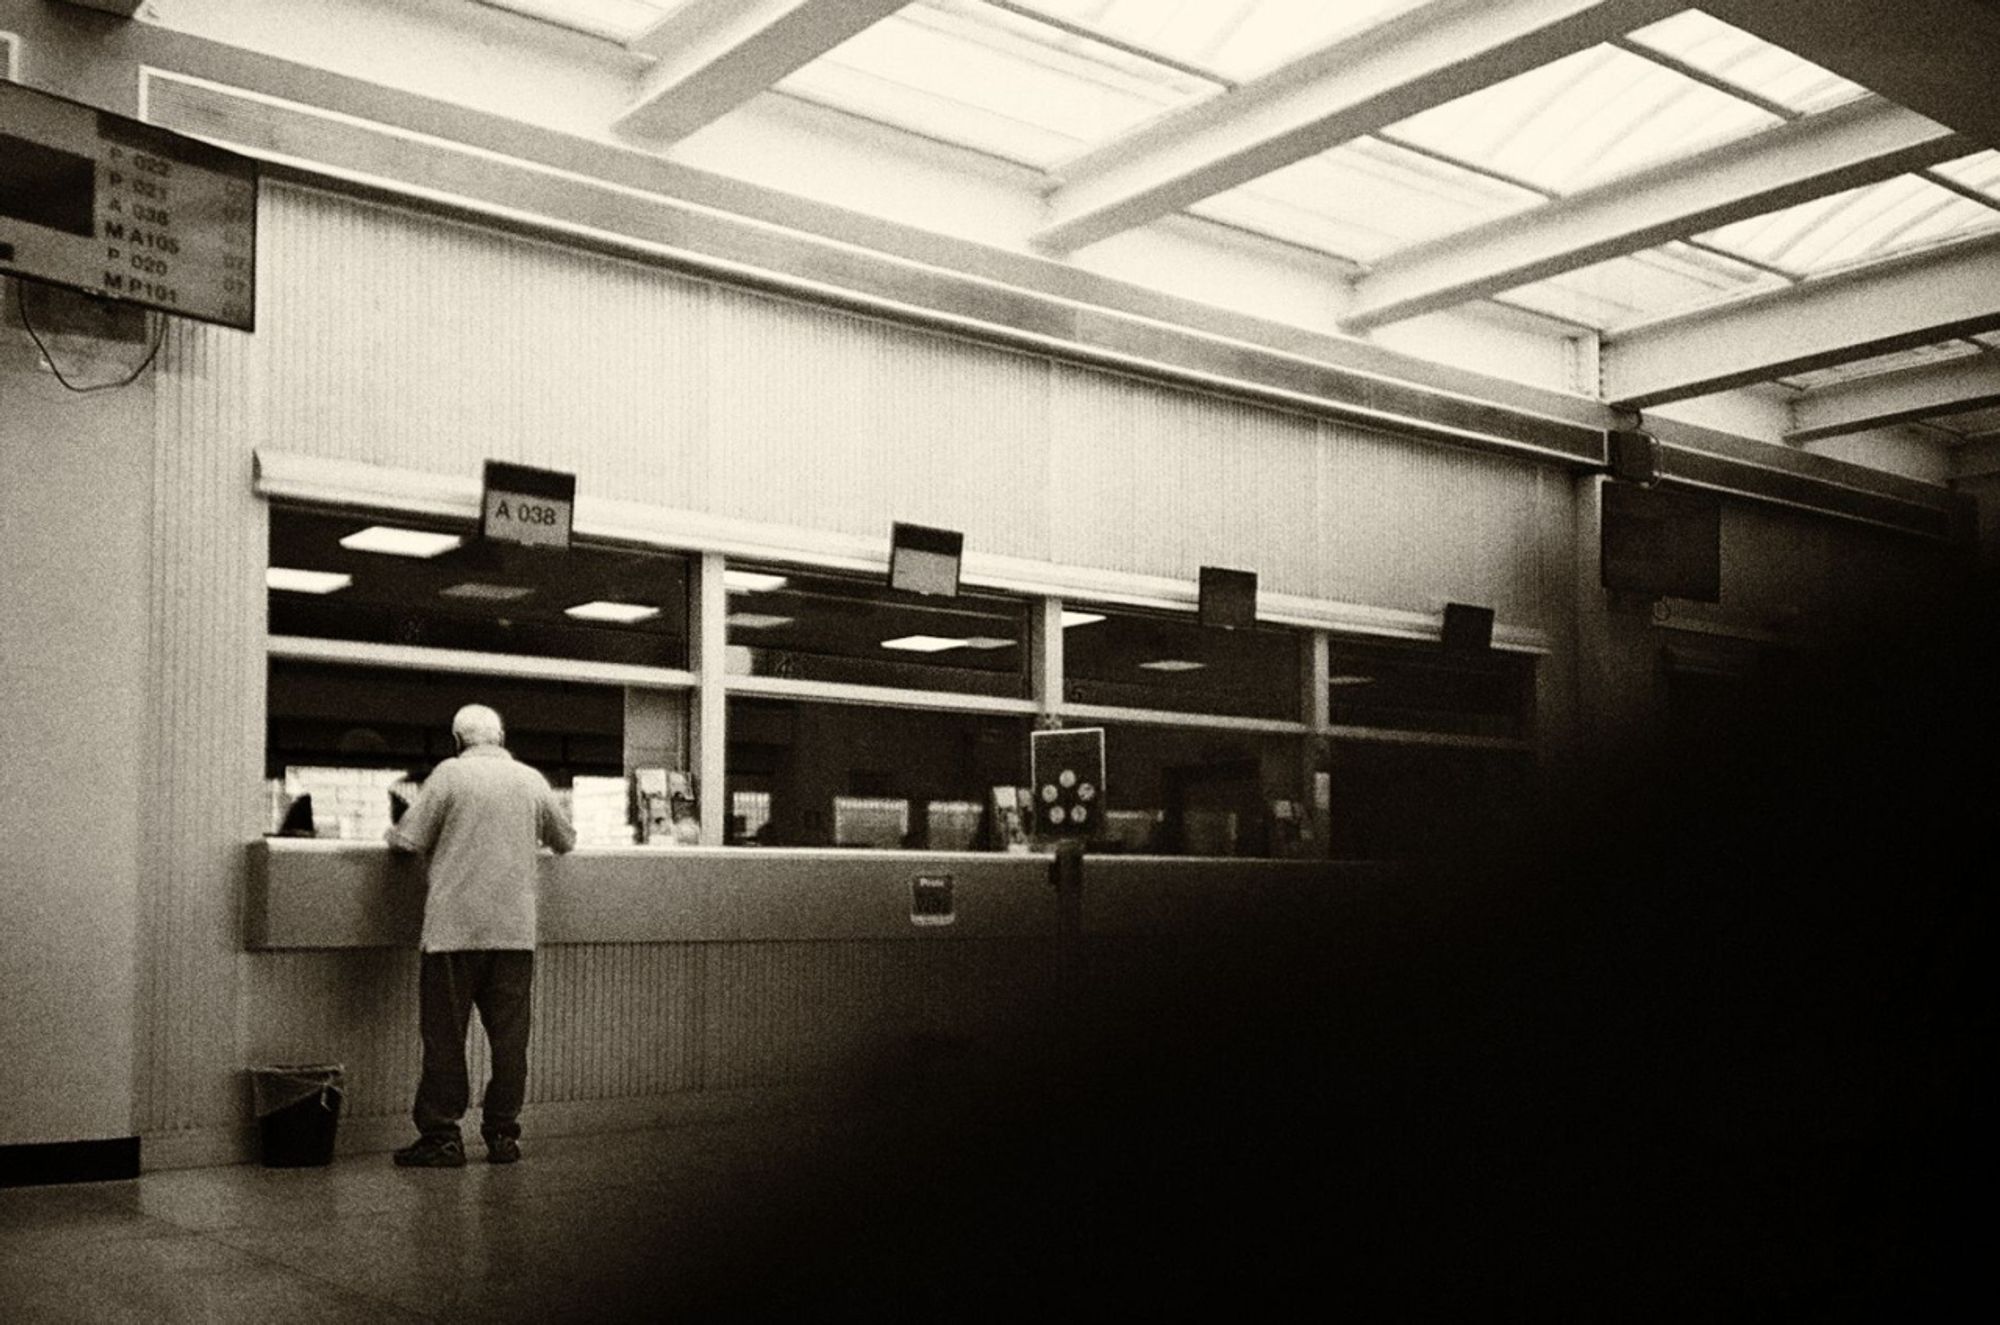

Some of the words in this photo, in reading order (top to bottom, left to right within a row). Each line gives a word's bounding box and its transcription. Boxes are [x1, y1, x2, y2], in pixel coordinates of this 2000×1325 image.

[109, 171, 123, 186] P
[108, 198, 122, 214] A
[104, 220, 124, 240] M
[107, 247, 121, 260] P
[103, 271, 123, 290] M
[129, 278, 178, 303] P101
[495, 499, 510, 519] A
[517, 503, 556, 526] 038
